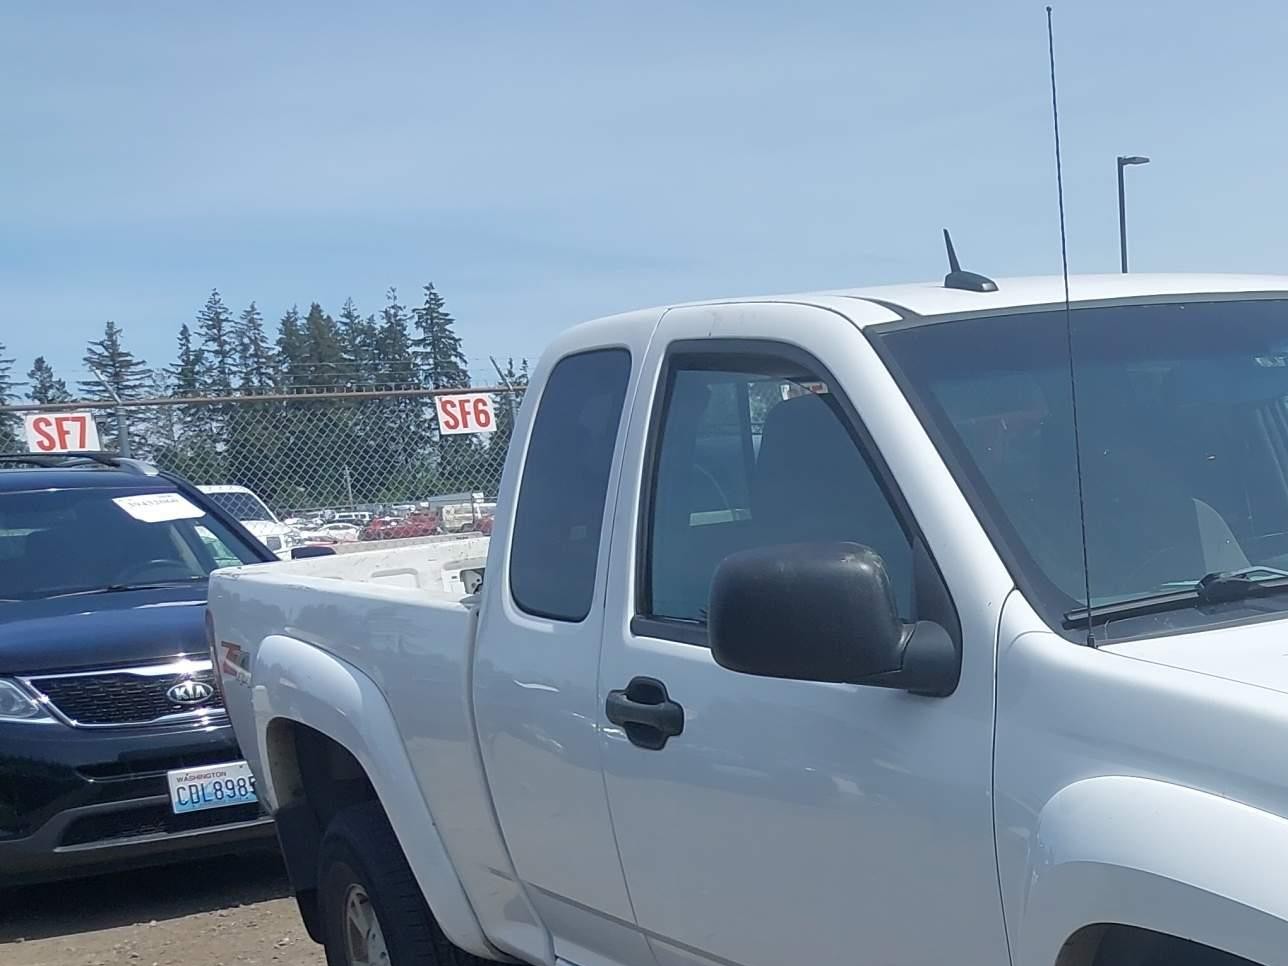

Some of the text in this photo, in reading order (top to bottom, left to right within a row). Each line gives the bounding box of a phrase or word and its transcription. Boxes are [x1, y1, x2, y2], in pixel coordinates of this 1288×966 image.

[440, 398, 490, 430] SF6
[32, 416, 86, 452] SF7
[174, 683, 208, 701] KIA
[176, 771, 227, 783] WASHINGTON
